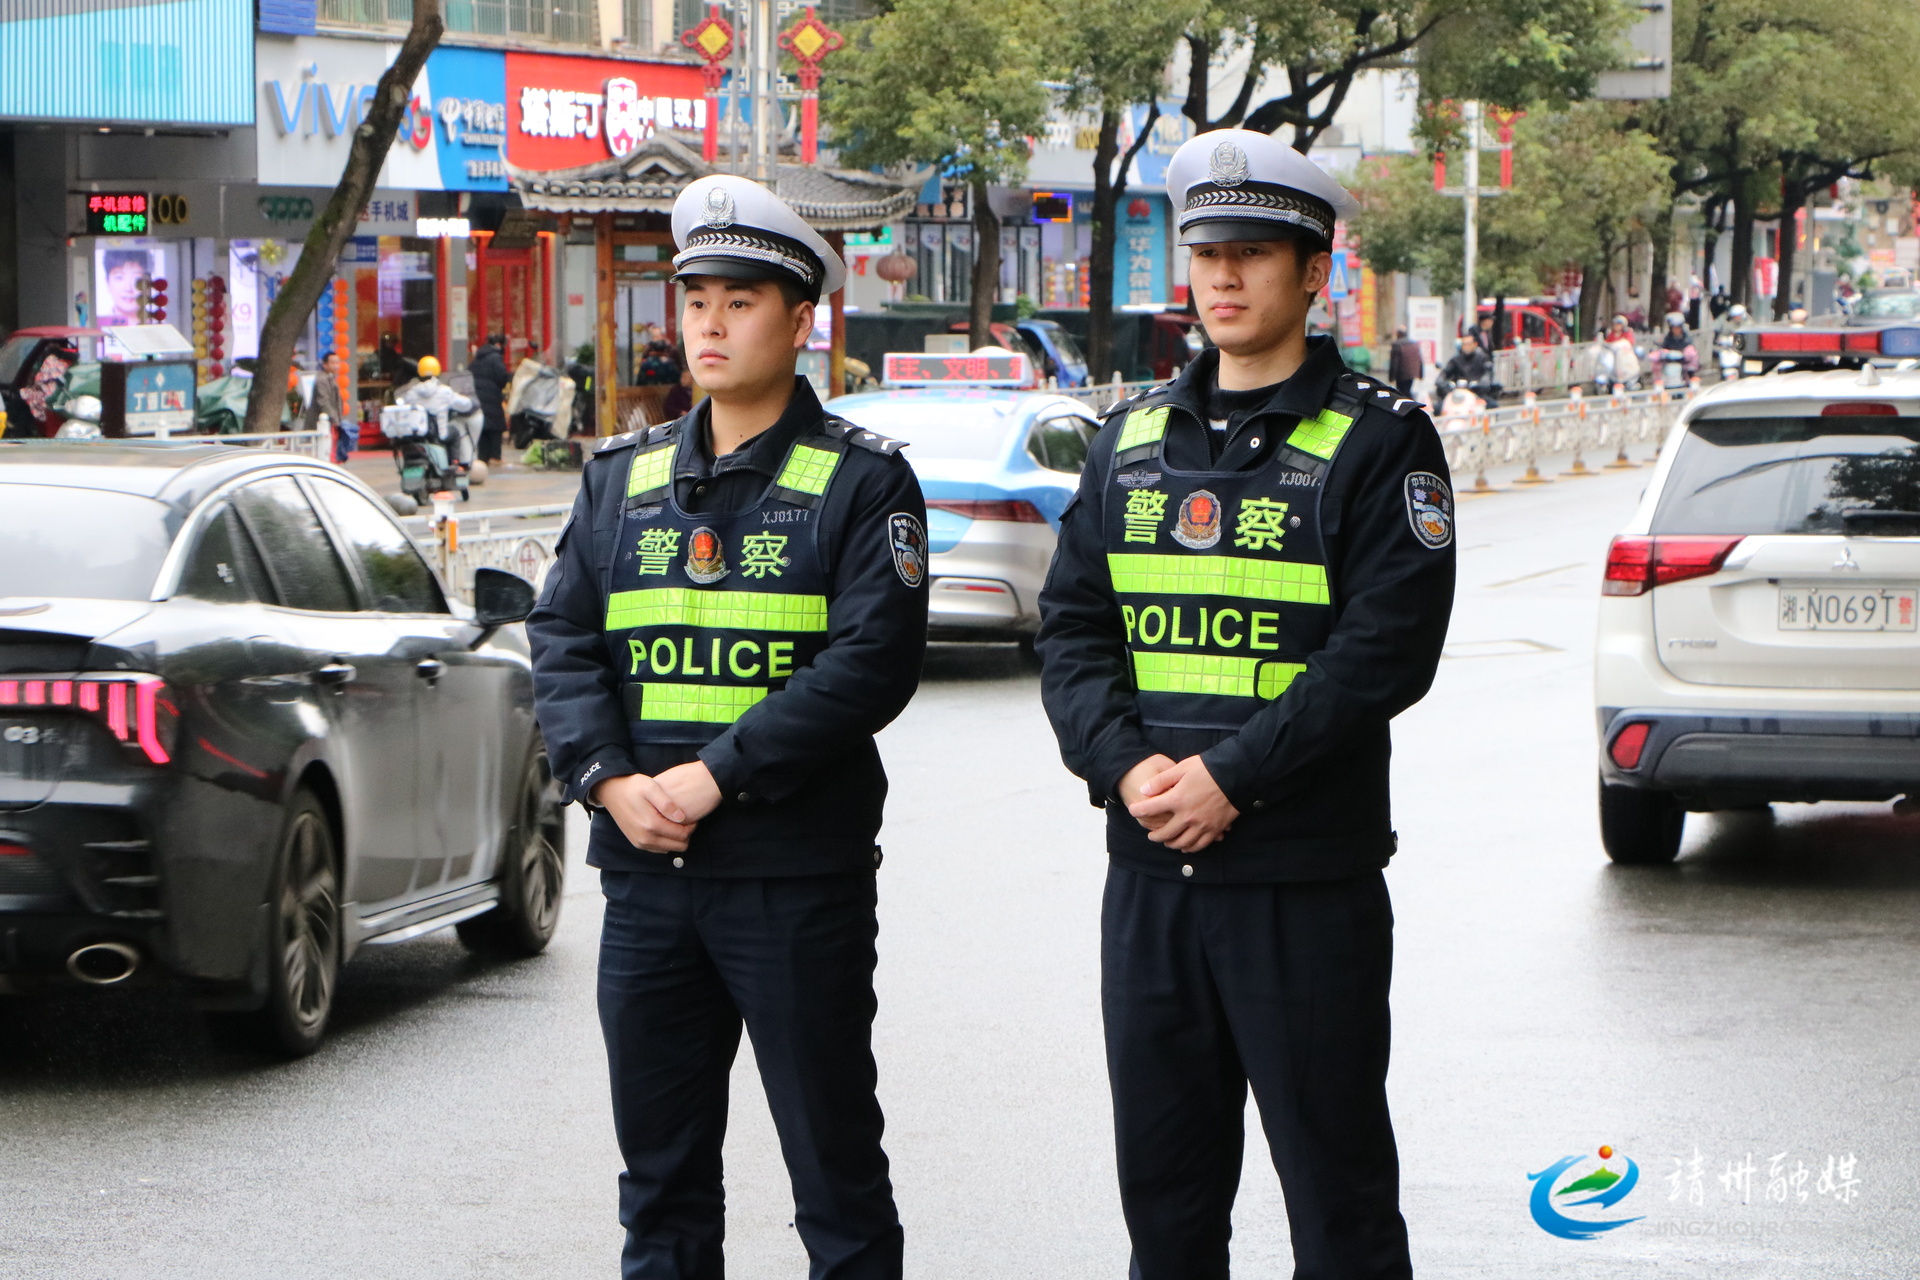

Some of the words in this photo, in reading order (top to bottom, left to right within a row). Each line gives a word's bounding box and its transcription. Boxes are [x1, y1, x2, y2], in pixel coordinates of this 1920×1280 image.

[90, 196, 146, 213] 手机维修
[103, 214, 146, 232] 机配件
[762, 509, 810, 525] XJ0177
[1124, 489, 1169, 544] 警
[1234, 497, 1289, 551] 察
[636, 528, 682, 576] 警
[740, 531, 789, 579] 察
[1121, 605, 1280, 650] POLICE
[627, 637, 795, 678] POLICE
[580, 761, 601, 786] POLICE
